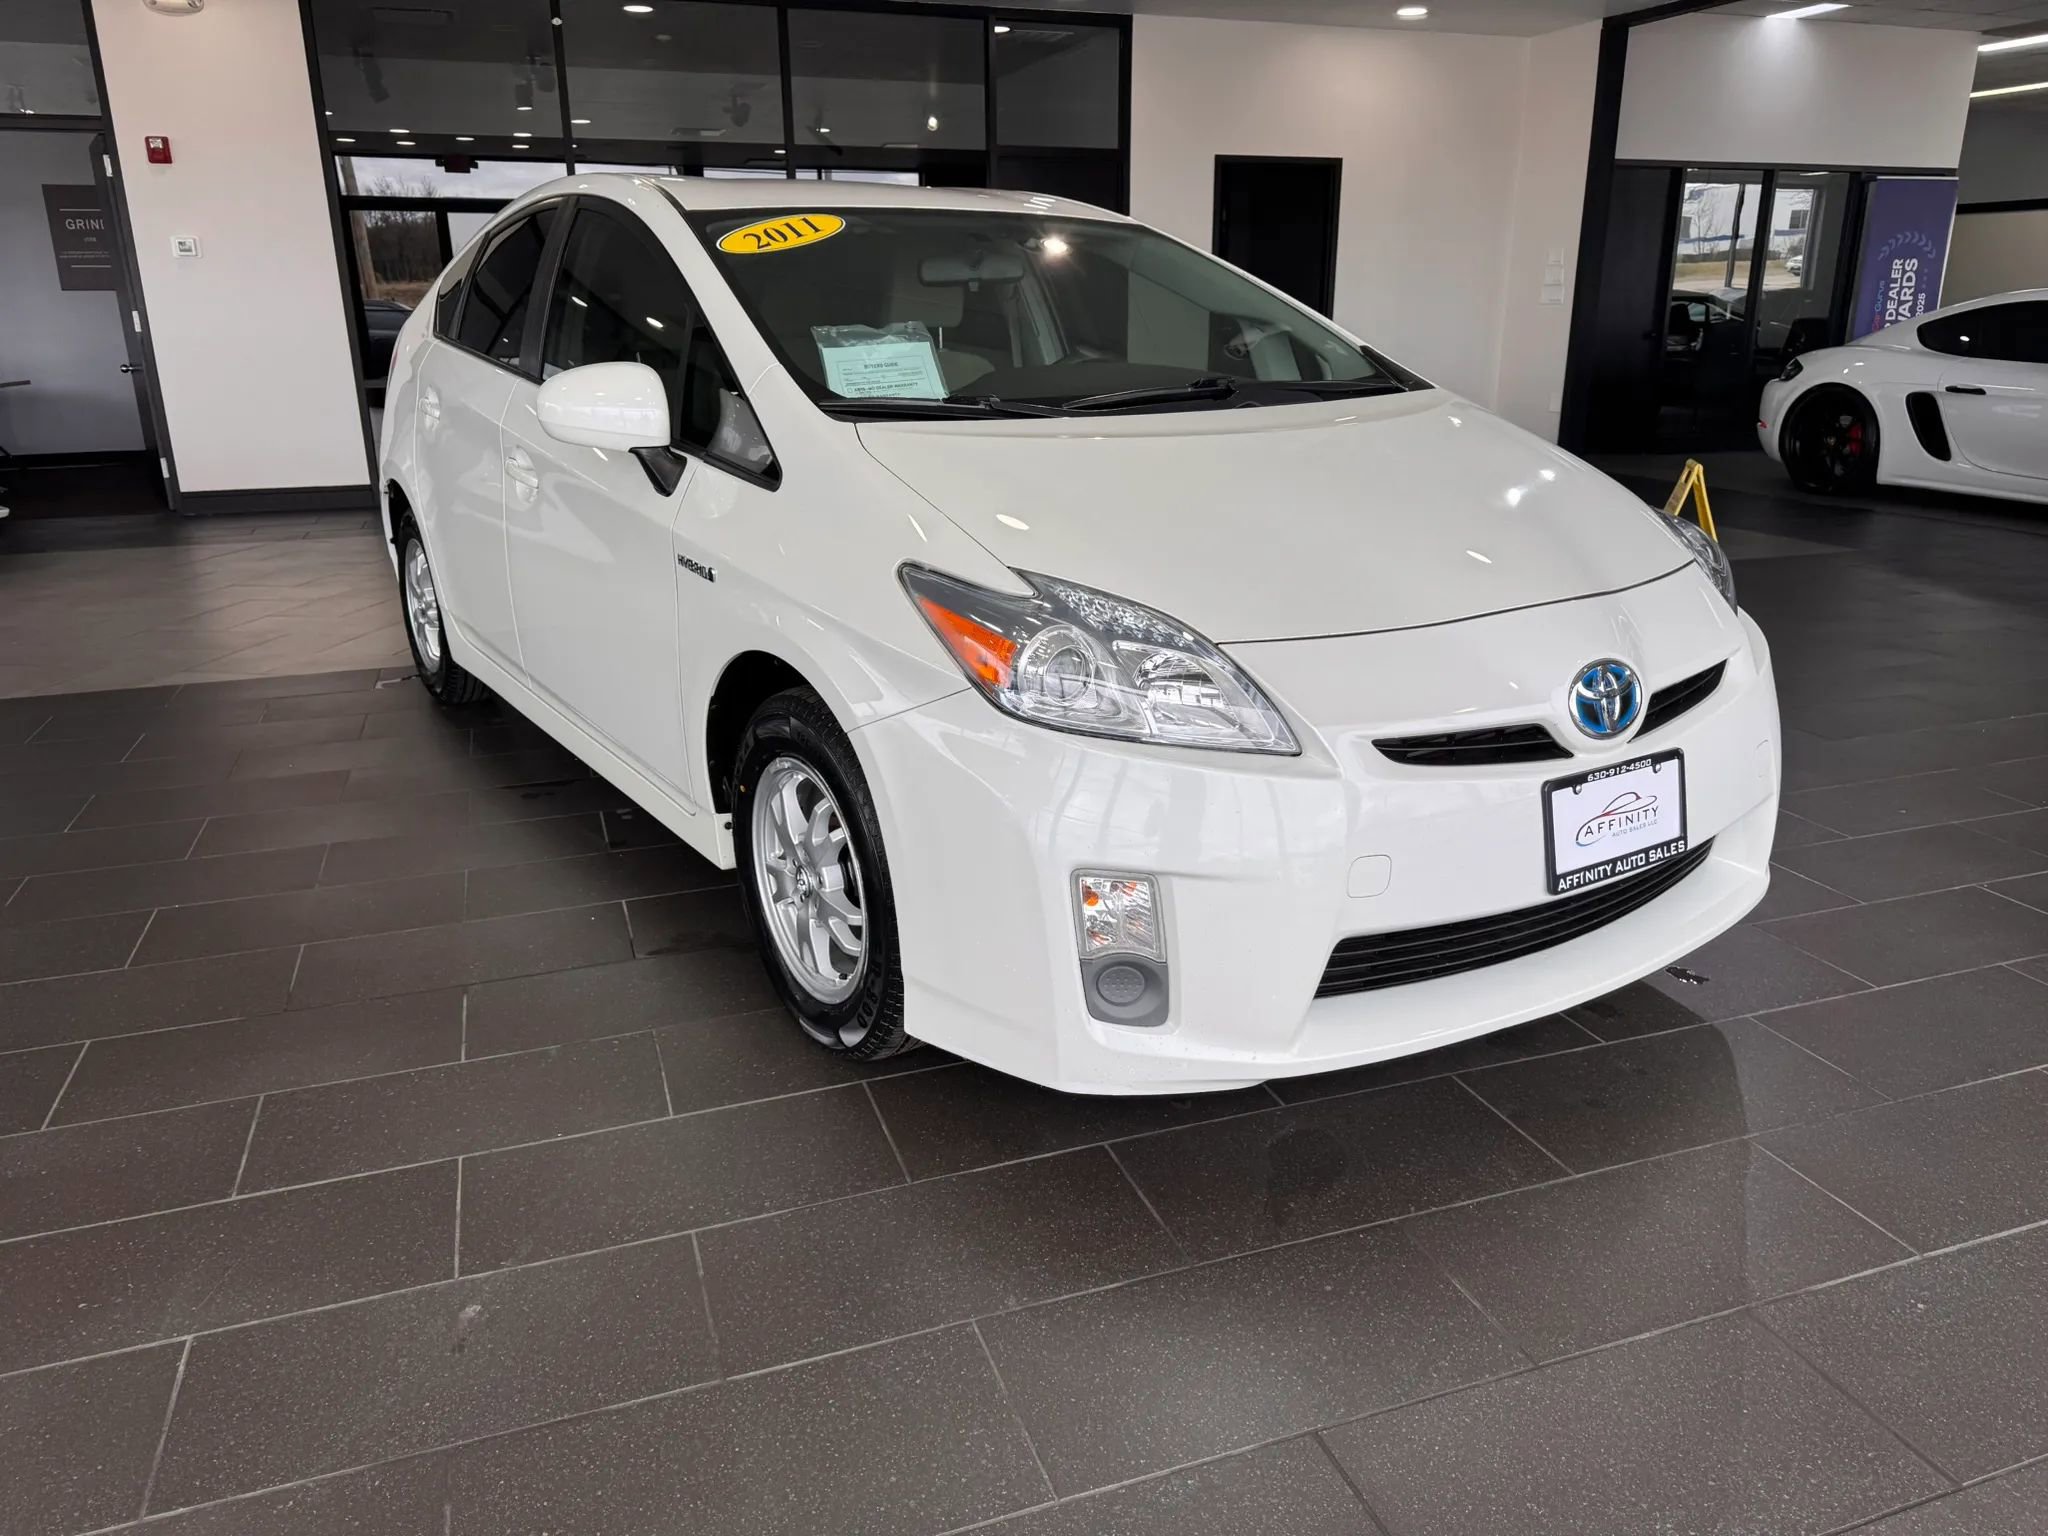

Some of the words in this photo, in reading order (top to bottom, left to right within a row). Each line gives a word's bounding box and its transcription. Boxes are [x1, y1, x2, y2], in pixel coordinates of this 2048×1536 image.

[742, 217, 824, 250] 2011
[1884, 258, 1904, 320] DEALER
[1587, 758, 1652, 782] 630-912-4500
[1584, 805, 1659, 837] AFFINITY
[1612, 828, 1628, 838] AUTO
[1629, 822, 1647, 833] SALES
[1557, 863, 1613, 891] AFFINITY
[1615, 853, 1646, 874] AUTO
[1648, 840, 1686, 862] SALES
